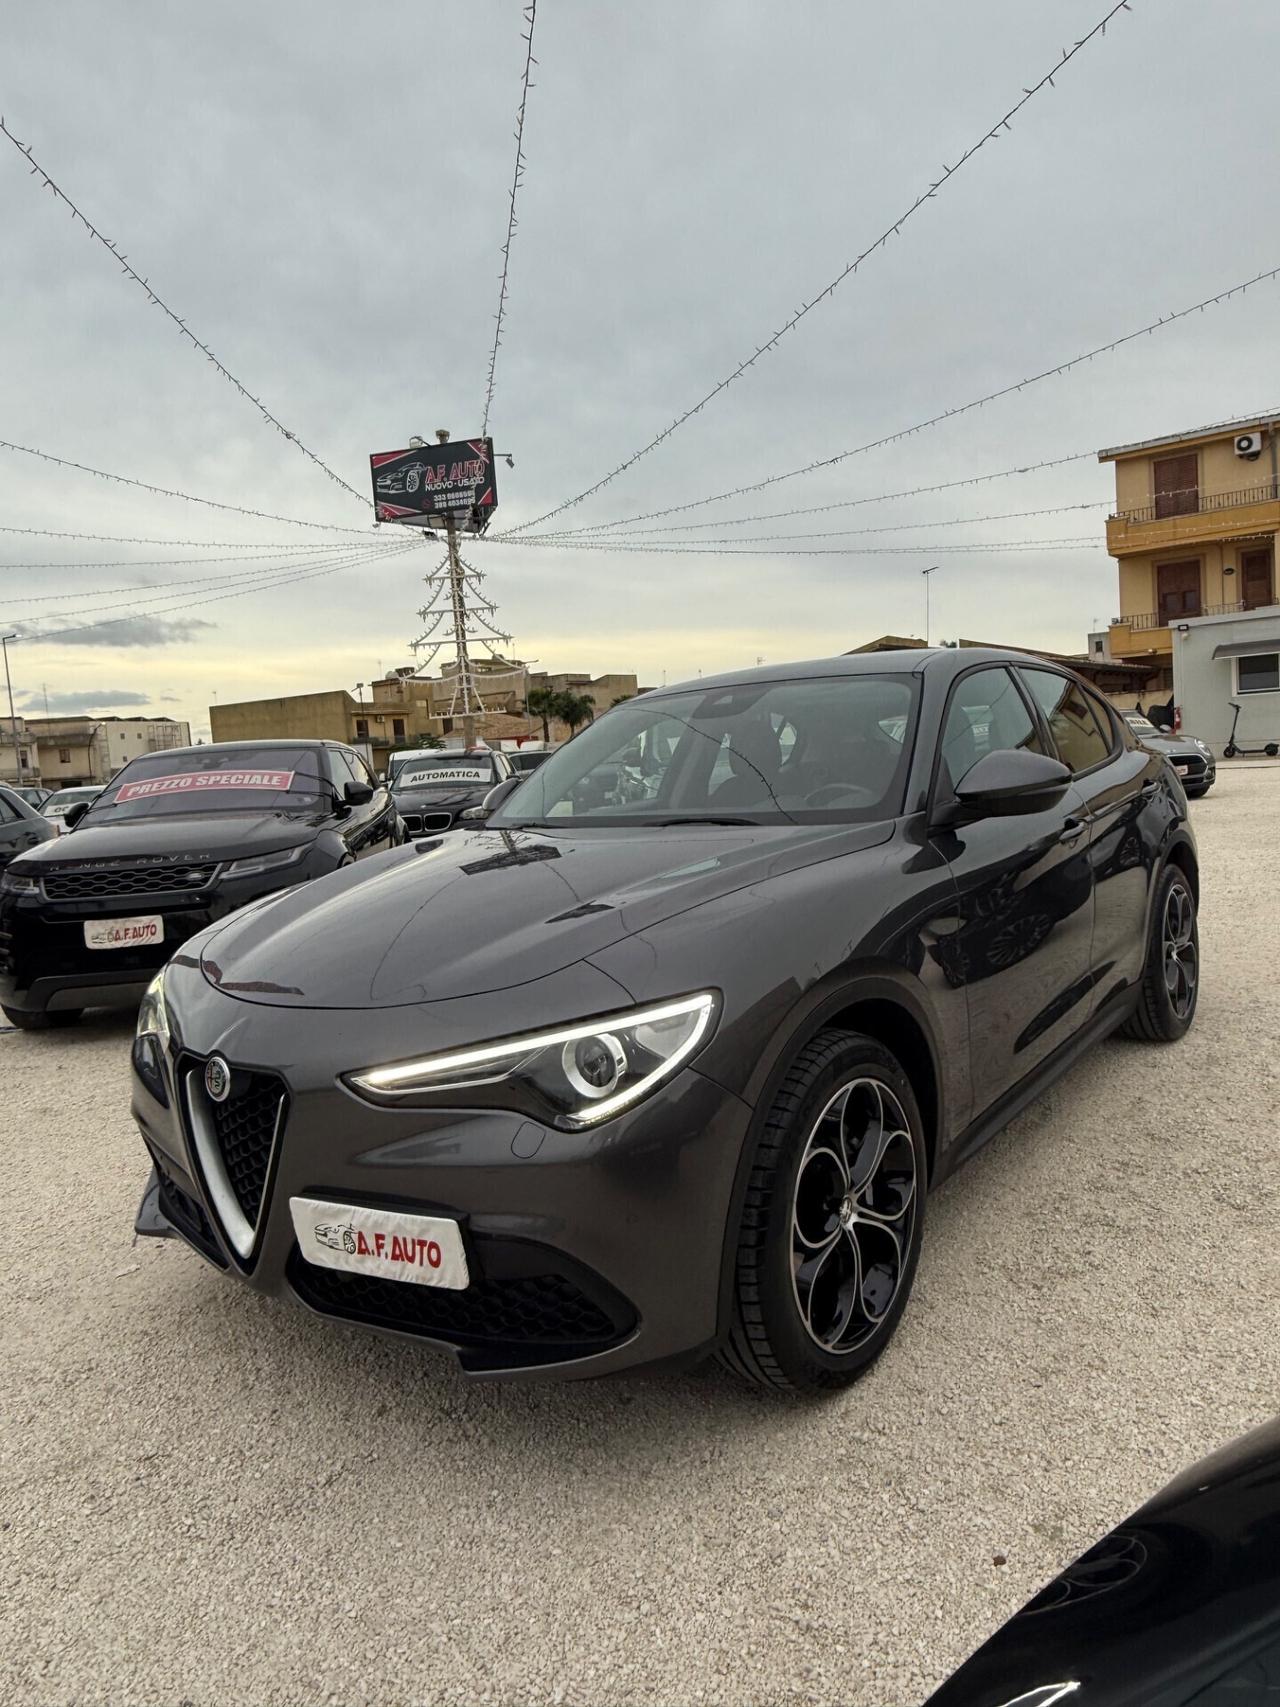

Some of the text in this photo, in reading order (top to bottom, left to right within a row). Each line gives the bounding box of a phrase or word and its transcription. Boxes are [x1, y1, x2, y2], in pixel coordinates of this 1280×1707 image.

[449, 459, 486, 480] AUTO
[457, 476, 485, 487] USAO
[410, 770, 481, 783] AUTOMATICA
[127, 774, 282, 797] PREZZO SPECIALE
